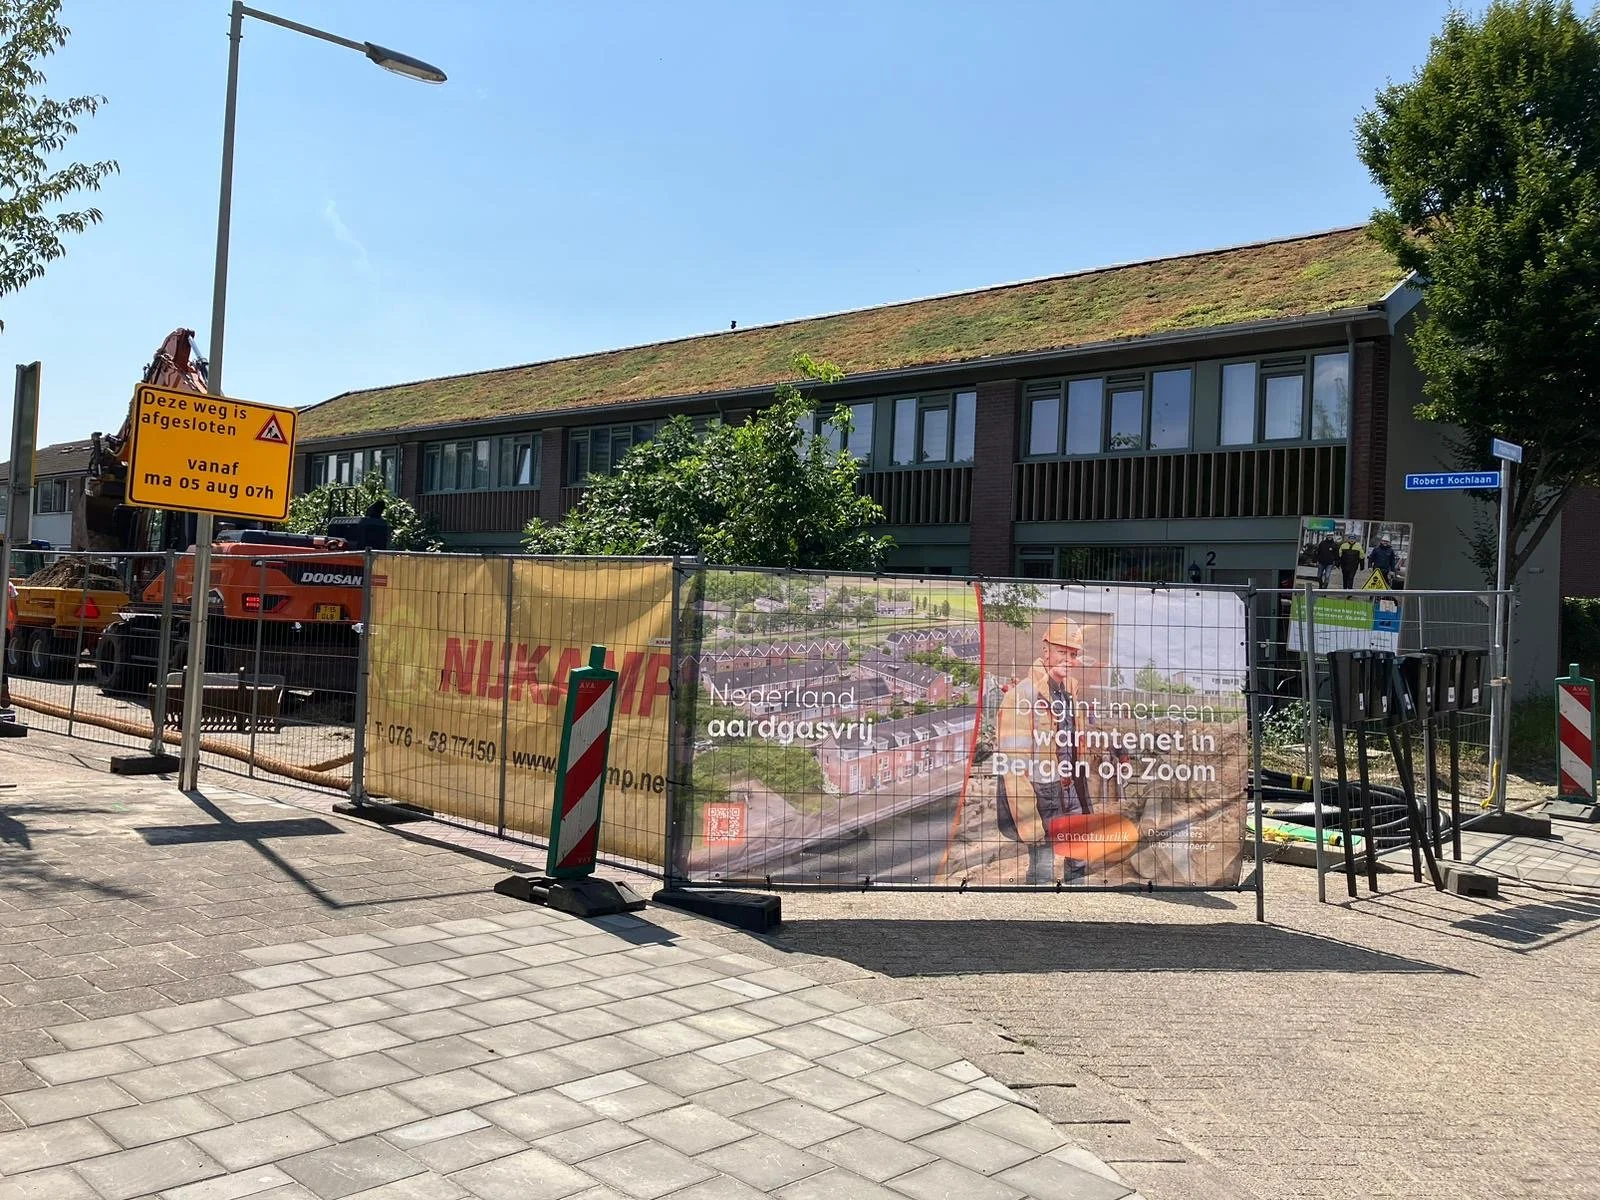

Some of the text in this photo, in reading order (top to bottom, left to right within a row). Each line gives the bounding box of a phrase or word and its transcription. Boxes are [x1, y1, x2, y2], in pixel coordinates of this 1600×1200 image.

[143, 391, 247, 420] Deze weg is
[141, 411, 236, 436] afgesloten
[187, 458, 240, 475] vanaf
[144, 472, 274, 500] ma 05 aug 07h
[1412, 475, 1492, 486] Robert Kochlaan
[1206, 550, 1217, 566] 2
[300, 572, 363, 586] DOOSAN
[709, 684, 856, 709] Nederland
[1015, 695, 1215, 723] begint met een
[388, 724, 413, 748] 076
[707, 714, 874, 745] aardgasvrij
[1033, 729, 1215, 752] warmtenet in
[991, 752, 1216, 784] Bergen op Zoom
[1056, 832, 1129, 844] ennatuurlijk
